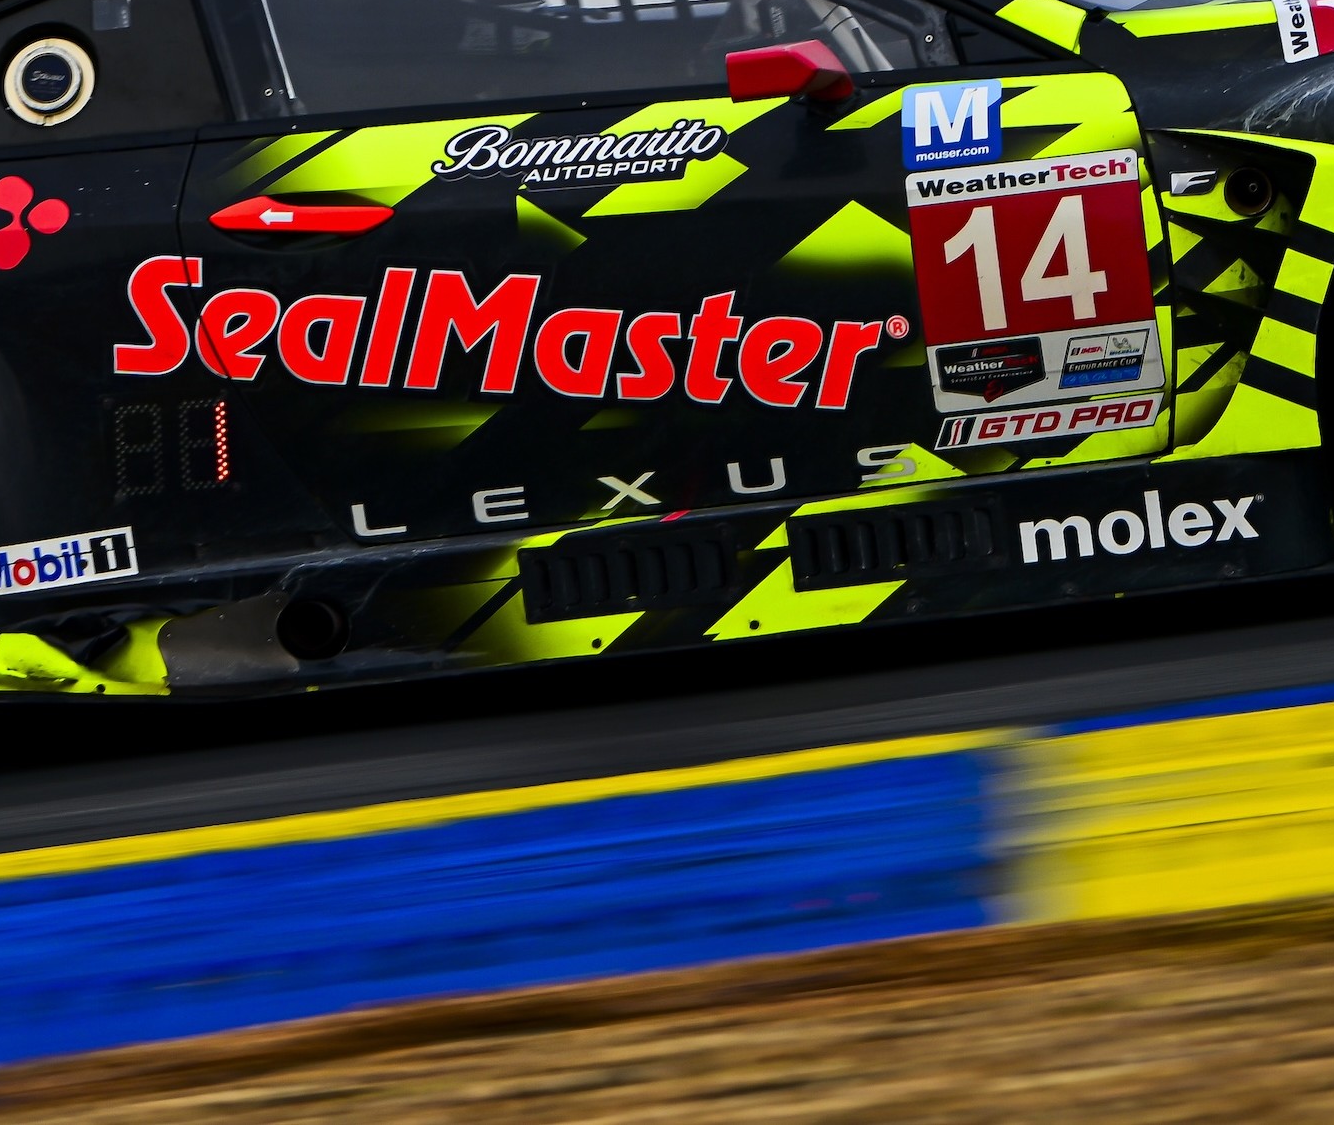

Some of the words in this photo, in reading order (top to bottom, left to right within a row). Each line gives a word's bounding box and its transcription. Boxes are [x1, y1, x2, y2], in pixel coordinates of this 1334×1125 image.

[914, 86, 990, 148] M
[433, 119, 722, 173] Bommarito
[915, 144, 990, 163] mouser.com
[524, 158, 684, 183] AUTOSPORT
[917, 159, 1128, 198] WeatherTech
[943, 195, 1108, 332] 14
[978, 411, 1062, 440] GTD
[1068, 399, 1154, 429] PRO
[352, 443, 918, 538] LEXUS
[99, 537, 117, 572] 1
